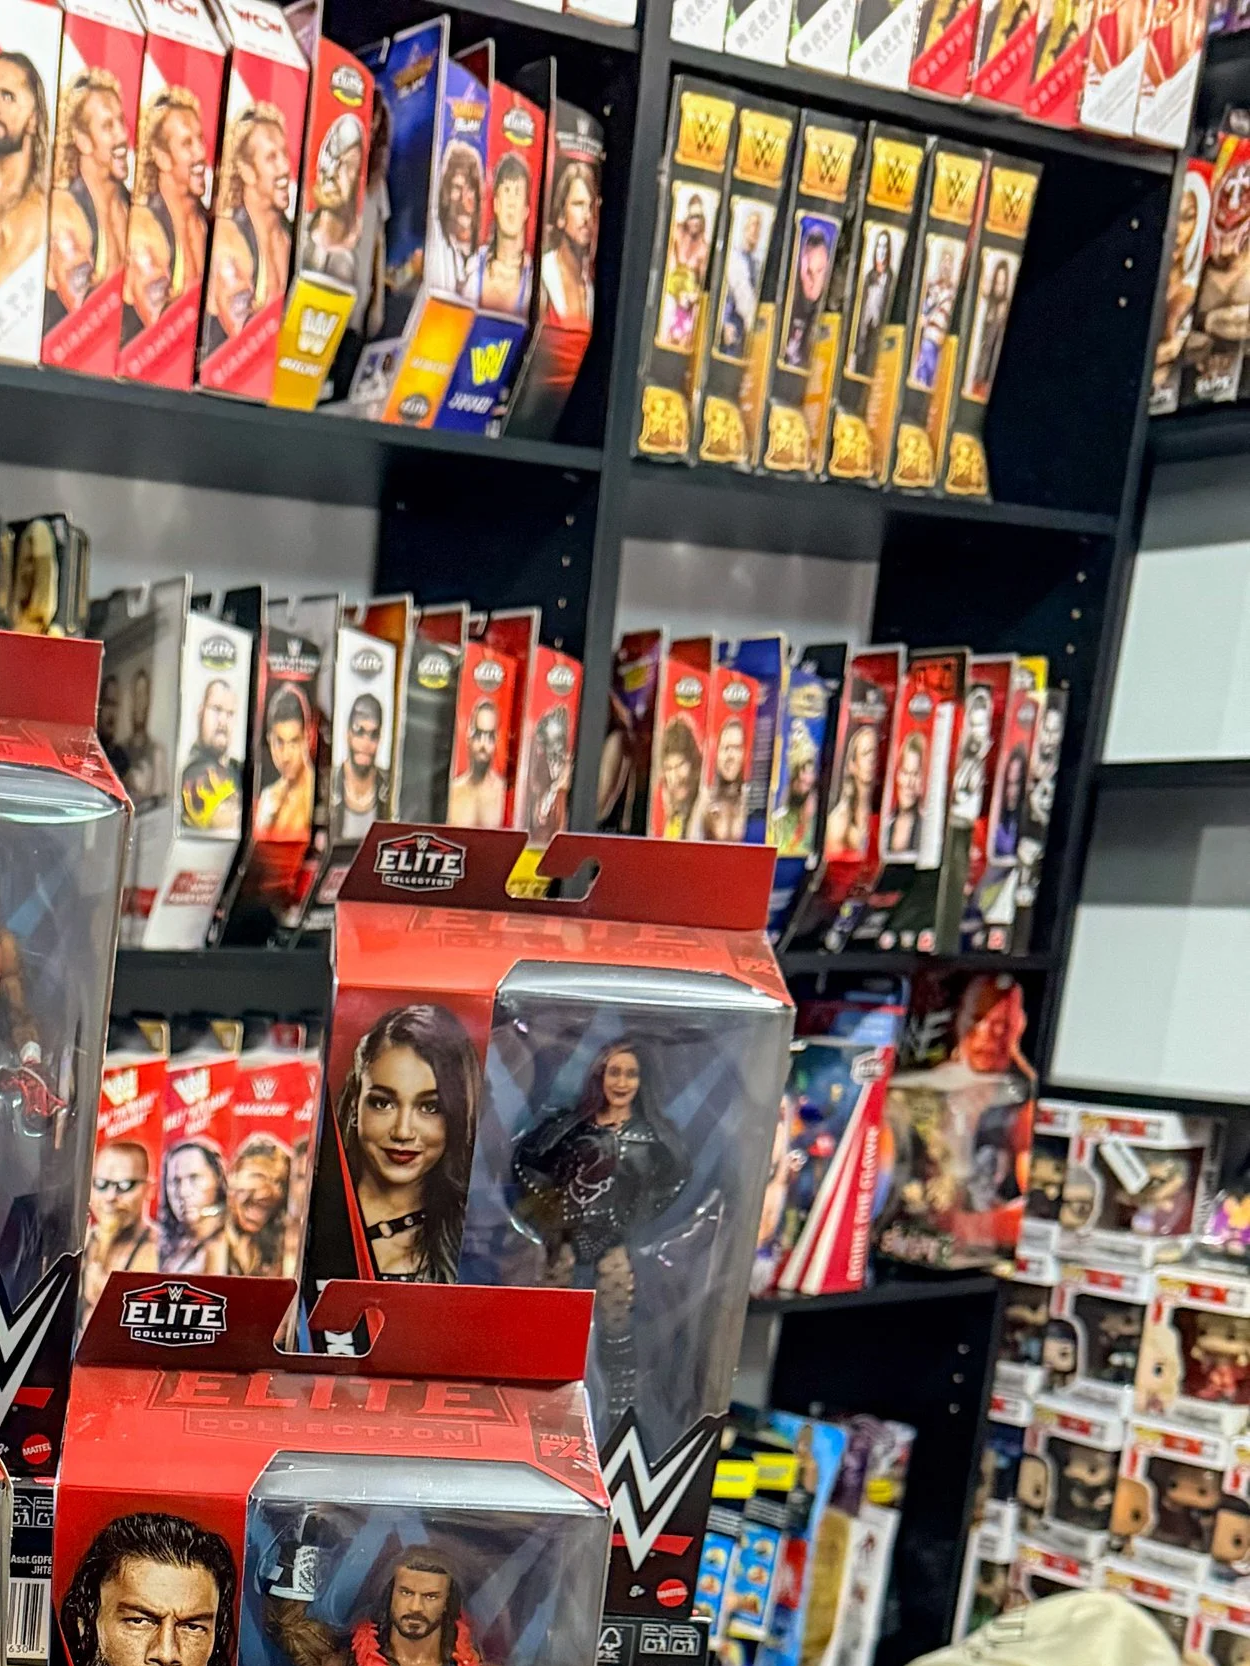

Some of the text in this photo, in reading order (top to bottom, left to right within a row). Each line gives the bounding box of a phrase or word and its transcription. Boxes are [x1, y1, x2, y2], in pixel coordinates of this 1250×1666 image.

[378, 850, 463, 875] ELITE
[384, 875, 451, 888] COLLECTION
[125, 1301, 225, 1328] ELITE
[133, 1329, 213, 1341] COLLECTION
[167, 1371, 497, 1418] ELITE
[199, 1418, 465, 1442] COLLECTION
[22, 1442, 52, 1456] MATTEL
[10, 1554, 53, 1565] Asst.GDF6
